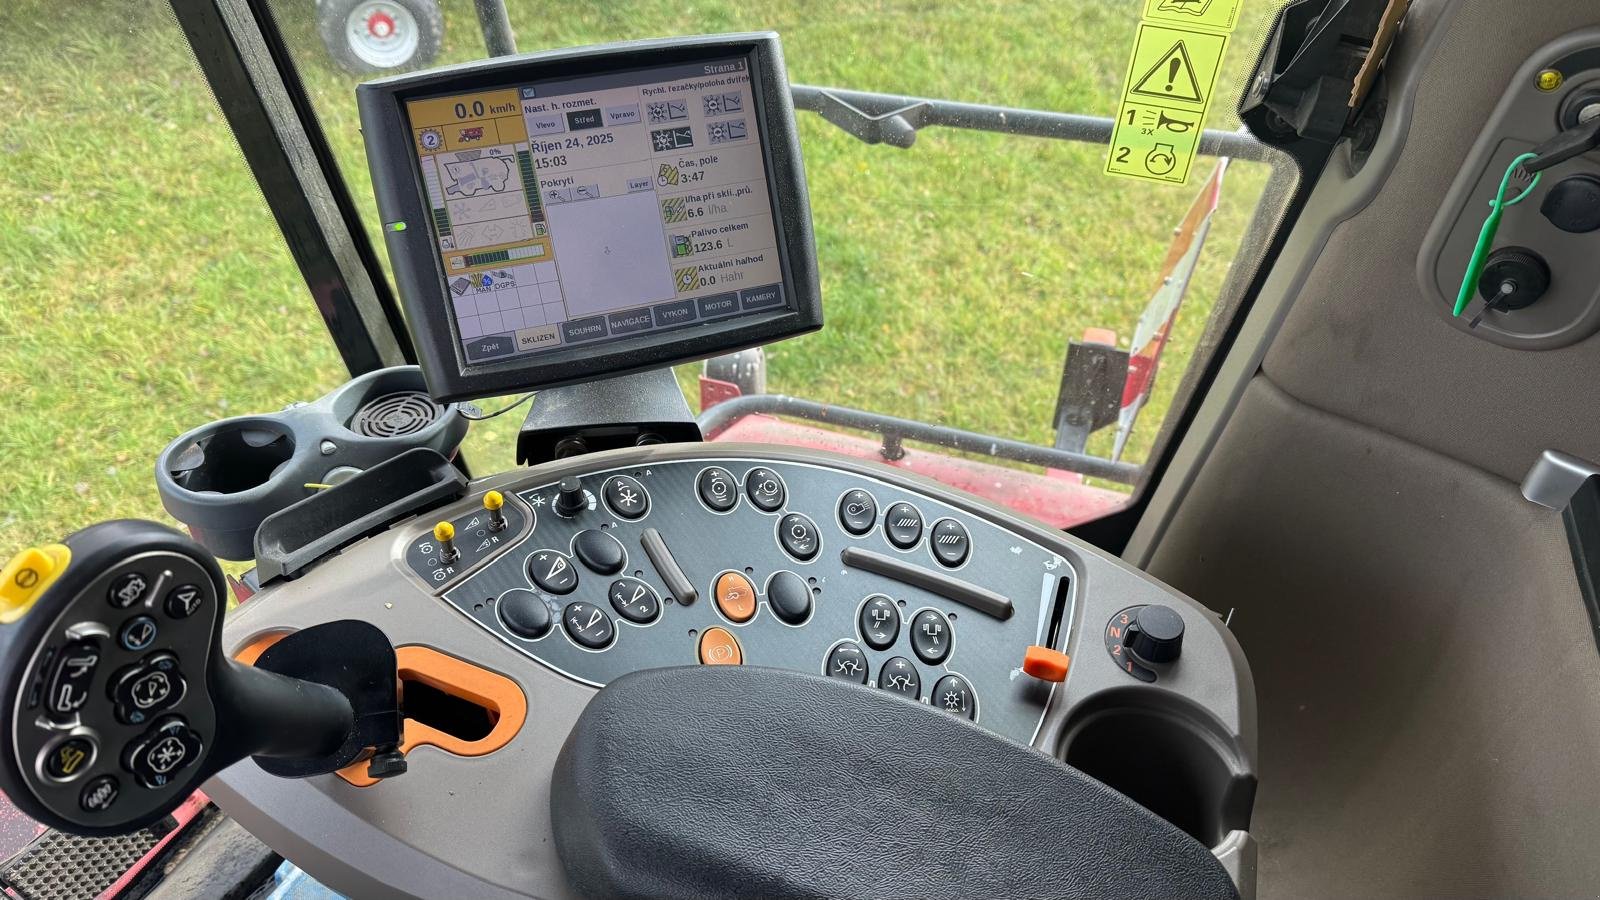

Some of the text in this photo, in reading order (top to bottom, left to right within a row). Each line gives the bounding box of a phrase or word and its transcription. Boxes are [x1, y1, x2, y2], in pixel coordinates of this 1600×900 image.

[704, 62, 744, 74] Strana 1
[642, 87, 666, 96] Rychl.
[455, 101, 516, 119] 0.0 km/h
[524, 98, 597, 114] Nast. h. rozmet.
[574, 115, 595, 124] Střed
[610, 110, 635, 120] Vpravo
[1127, 110, 1136, 125] 1
[1141, 128, 1154, 136] 3X
[427, 135, 435, 146] 2
[531, 133, 614, 154] Říjen 24, 2025
[489, 148, 501, 156] 0%
[1116, 147, 1131, 163] 2
[535, 155, 568, 170] 15:03
[678, 155, 718, 169] Čas, pole
[681, 171, 705, 184] 3:47
[630, 181, 648, 189] Layer
[687, 207, 704, 218] 6.6
[690, 222, 749, 238] Palivo celkem
[694, 240, 723, 253] 123.6
[735, 254, 764, 266] ha/hod
[700, 275, 716, 287] 0.0
[746, 291, 776, 303] KAMERY
[705, 300, 732, 311] MOTOR
[611, 315, 651, 328] NAVIGACE
[568, 325, 602, 336] SOUHRN
[482, 343, 500, 353] Zpět
[446, 566, 454, 574] R
[639, 605, 649, 613] 2
[1120, 614, 1128, 624] 3
[1110, 626, 1120, 638] N
[1112, 645, 1121, 656] 2
[1126, 661, 1134, 672] 1
